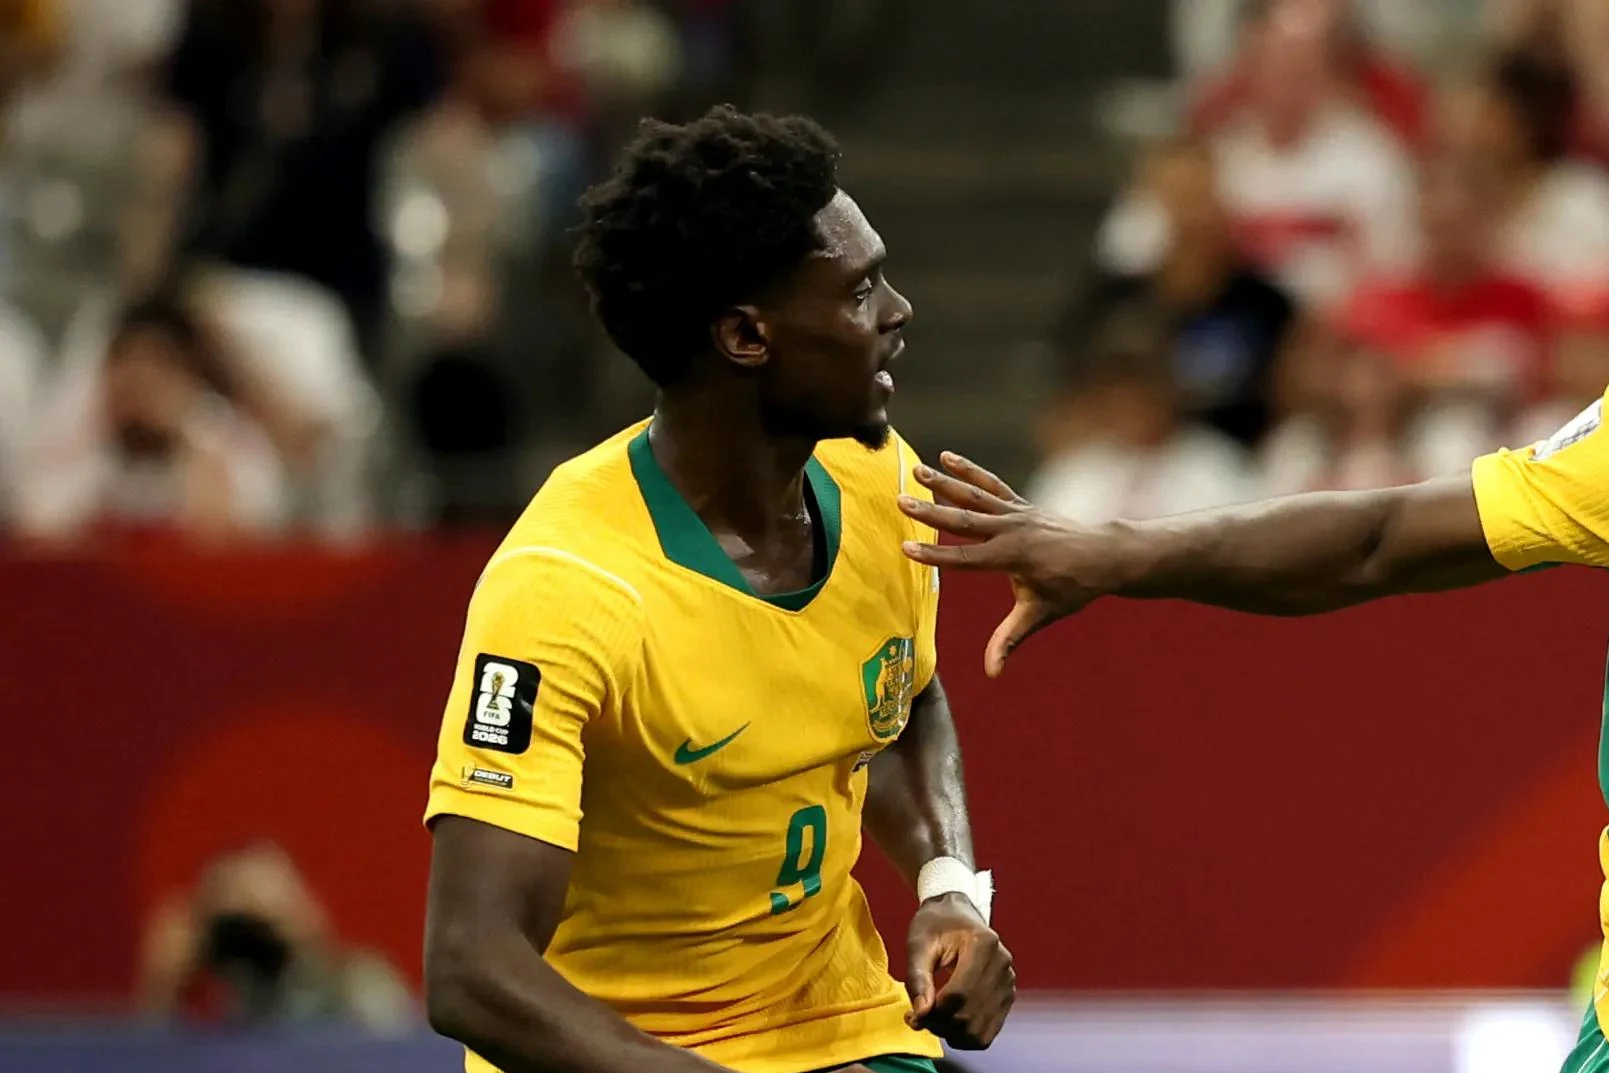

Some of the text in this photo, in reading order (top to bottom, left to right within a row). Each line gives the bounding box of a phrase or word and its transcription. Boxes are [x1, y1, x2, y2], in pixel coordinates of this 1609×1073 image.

[483, 710, 501, 720] FIFA
[472, 729, 509, 745] 2026
[770, 804, 828, 915] 9
